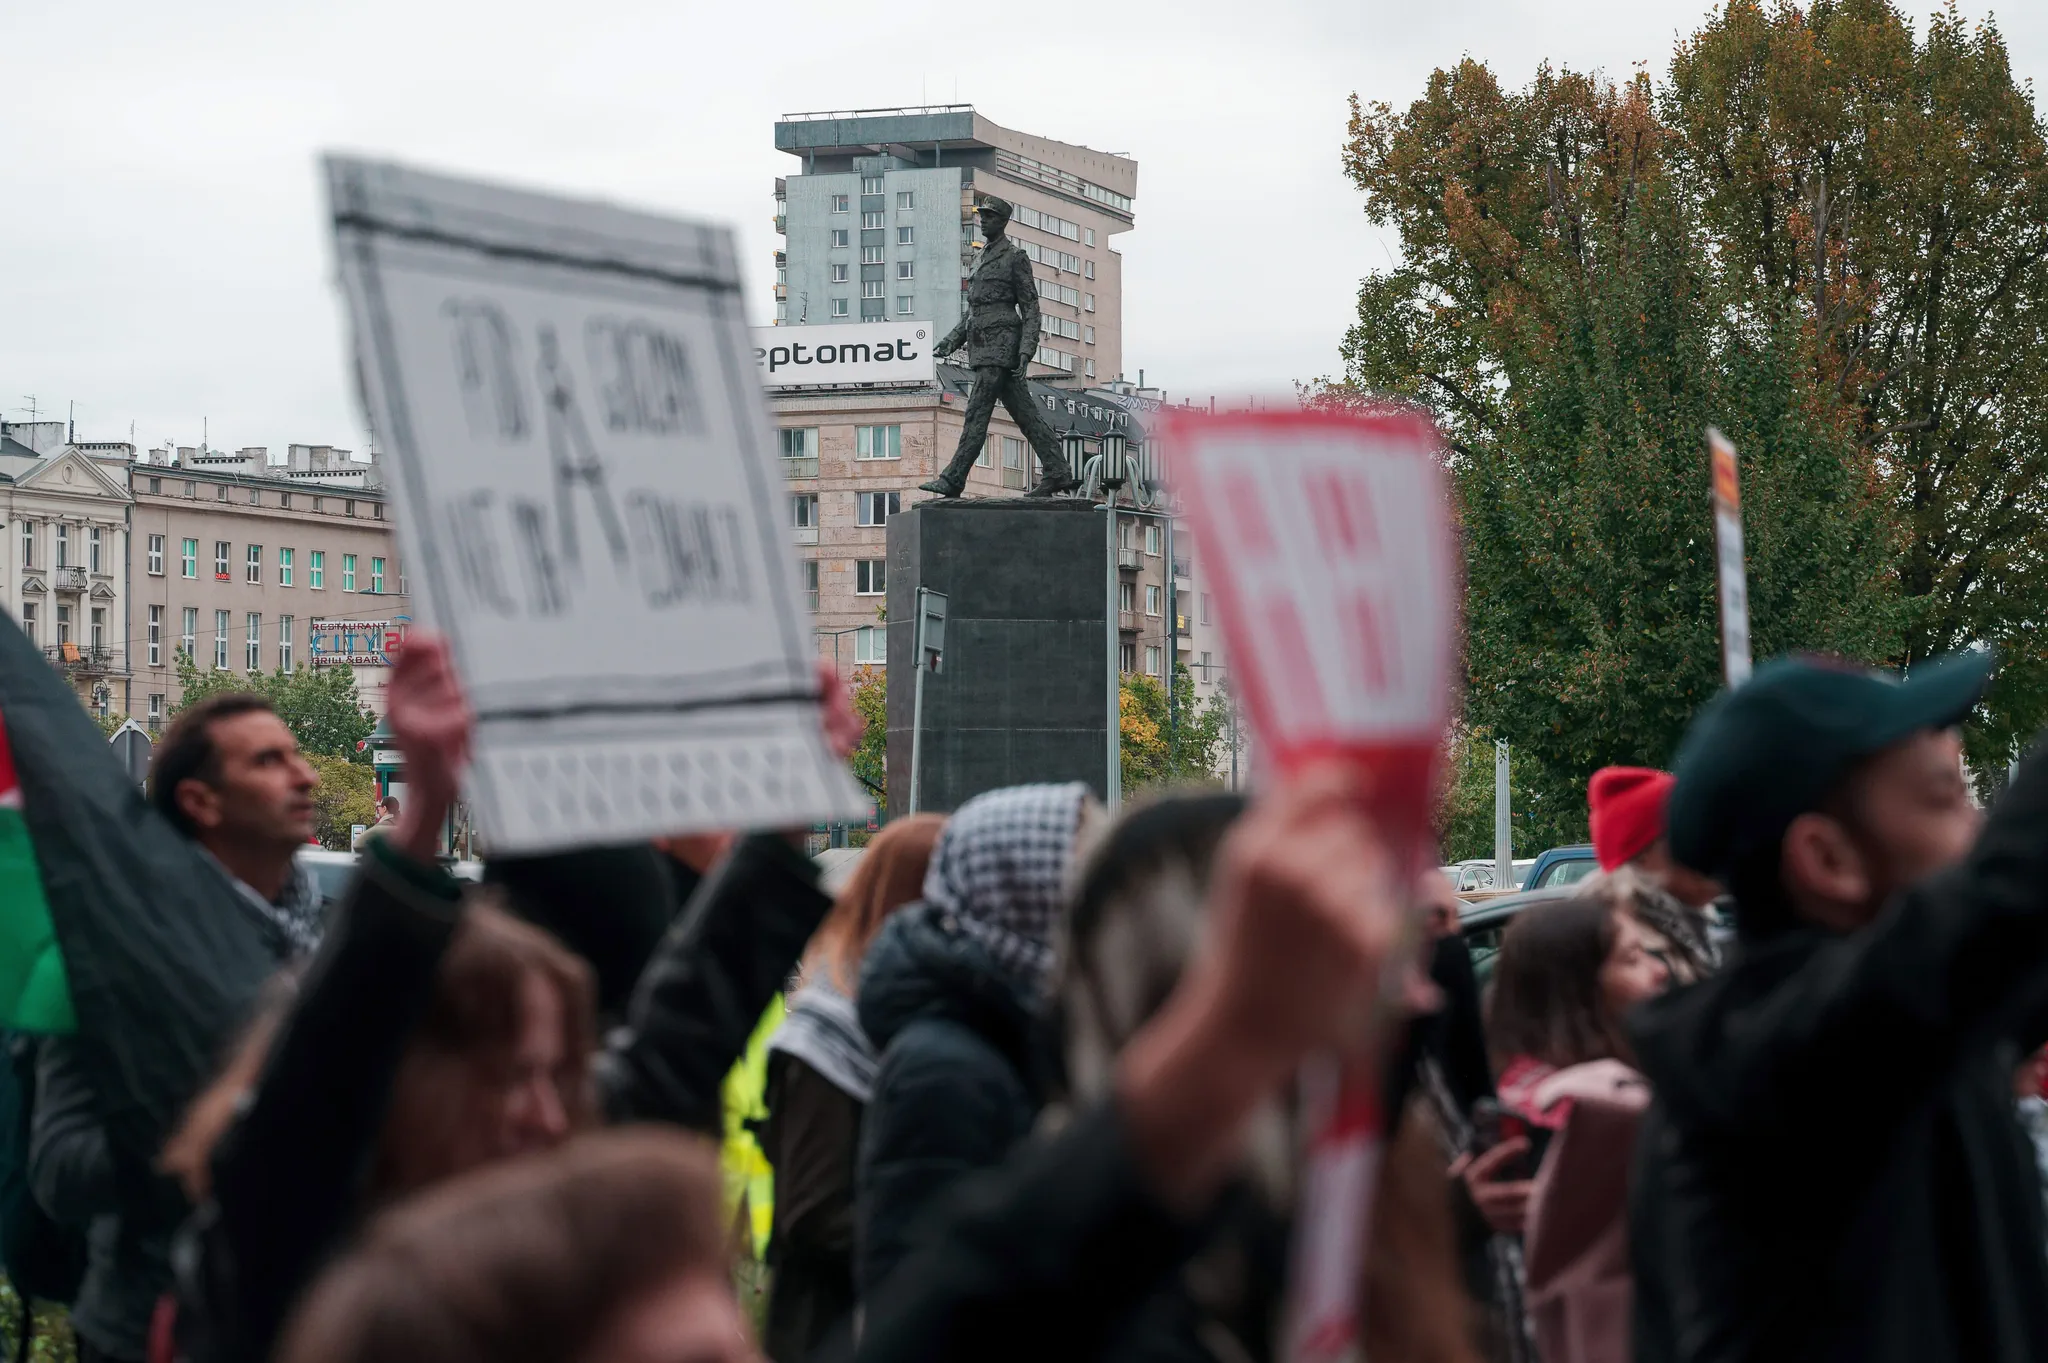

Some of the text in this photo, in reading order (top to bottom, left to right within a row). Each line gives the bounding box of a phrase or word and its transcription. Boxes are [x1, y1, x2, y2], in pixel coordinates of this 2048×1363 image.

[312, 622, 387, 631] RESTAURANT
[312, 633, 379, 653] CITY
[312, 656, 344, 665] GRILL
